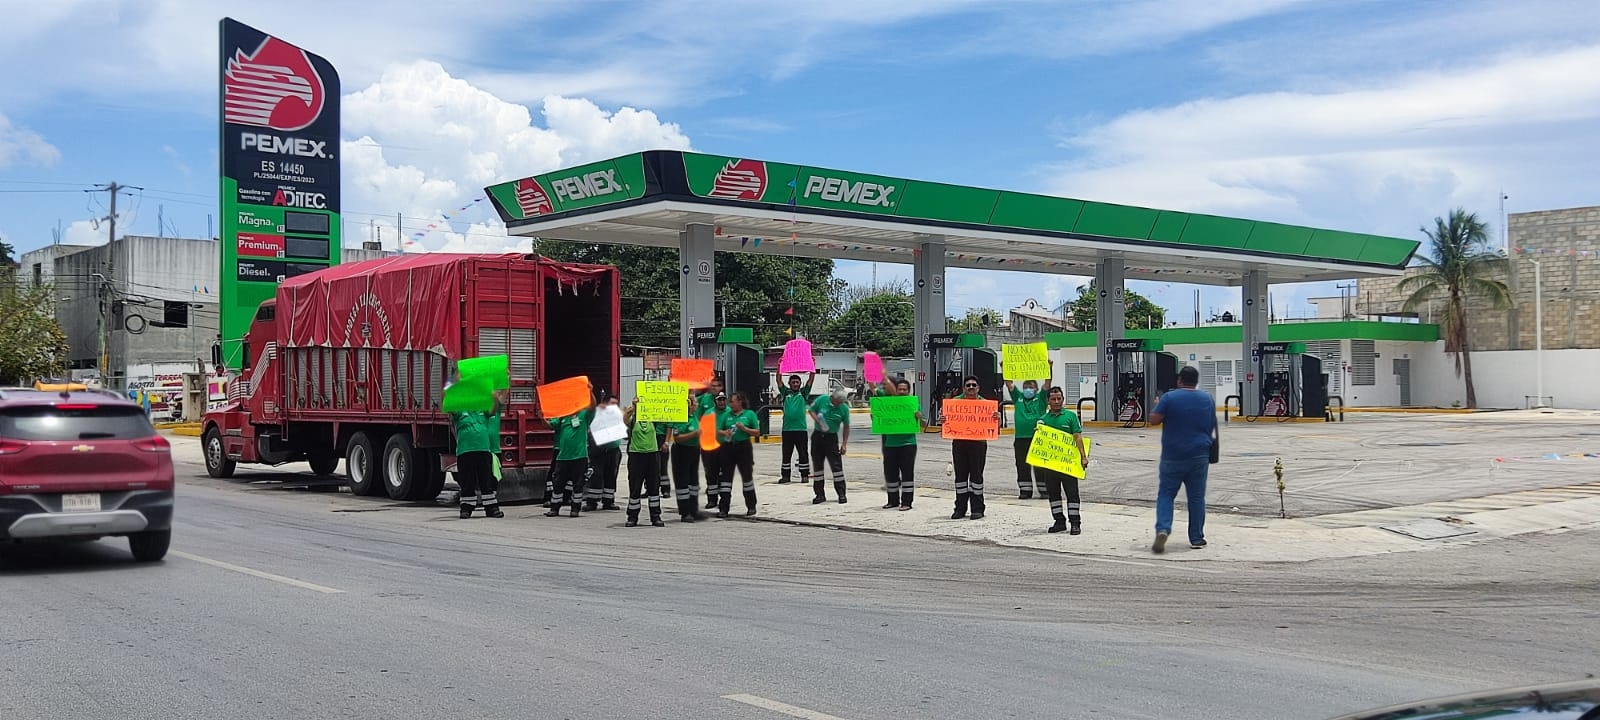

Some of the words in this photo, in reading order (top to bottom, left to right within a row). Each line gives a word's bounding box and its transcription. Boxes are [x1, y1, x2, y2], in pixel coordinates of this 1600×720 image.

[241, 132, 326, 158] PEMEX
[261, 160, 275, 172] ES
[280, 162, 304, 175] 14450
[552, 169, 622, 202] PEMEX
[803, 175, 894, 207] PEMEX
